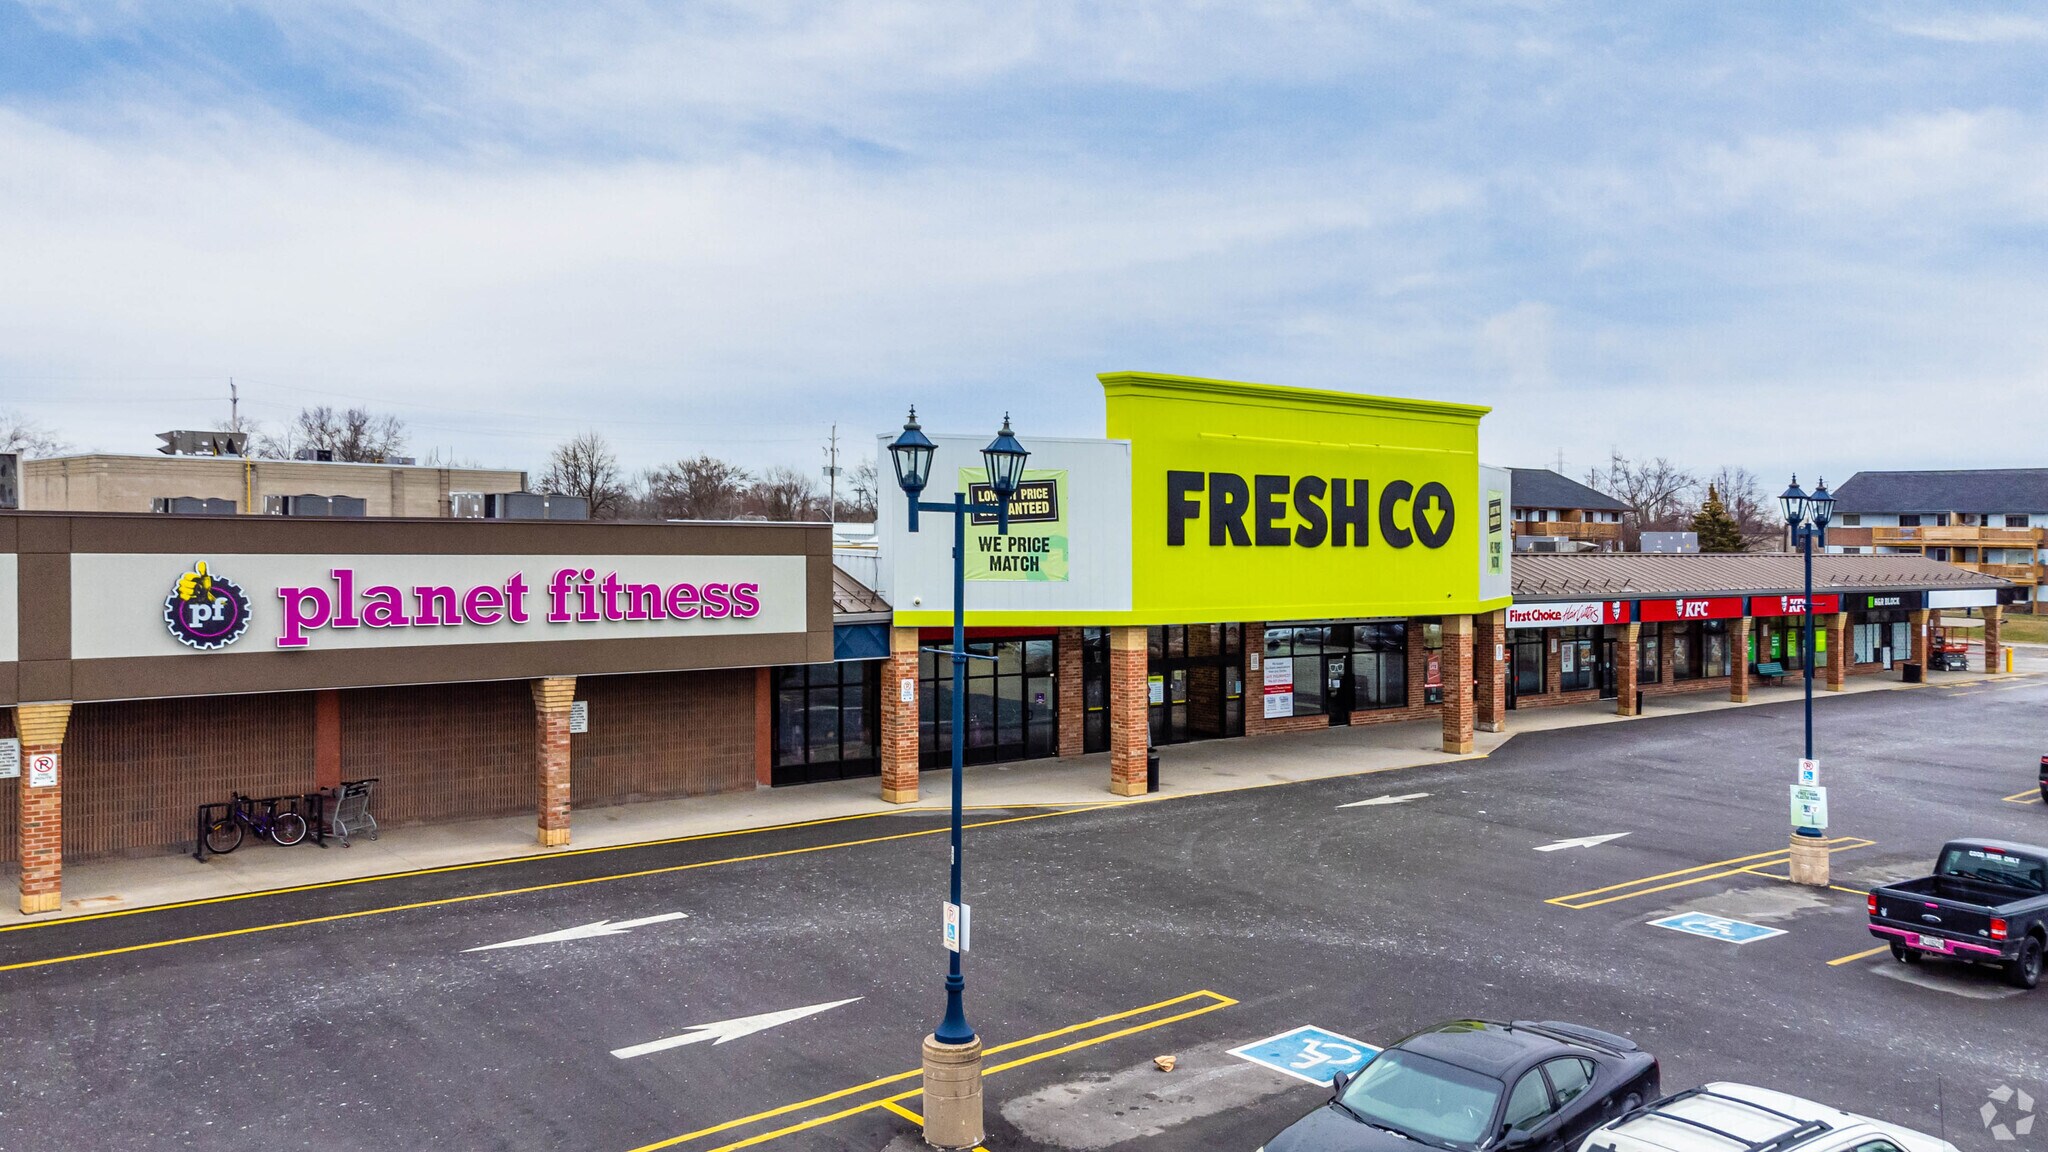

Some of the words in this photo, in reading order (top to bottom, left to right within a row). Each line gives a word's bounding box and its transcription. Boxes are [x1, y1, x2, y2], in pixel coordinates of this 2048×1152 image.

[978, 490, 1017, 502] LOW
[1020, 488, 1049, 500] PRICE
[978, 536, 1002, 552] WE
[1008, 537, 1050, 553] PRICE
[989, 555, 1040, 572] MATCH
[189, 597, 228, 628] pf
[277, 568, 530, 647] planet
[548, 568, 760, 623] fitness
[1685, 601, 1709, 617] KFC
[1789, 598, 1806, 612] KF
[1509, 610, 1531, 622] First
[1532, 608, 1562, 621] Choice
